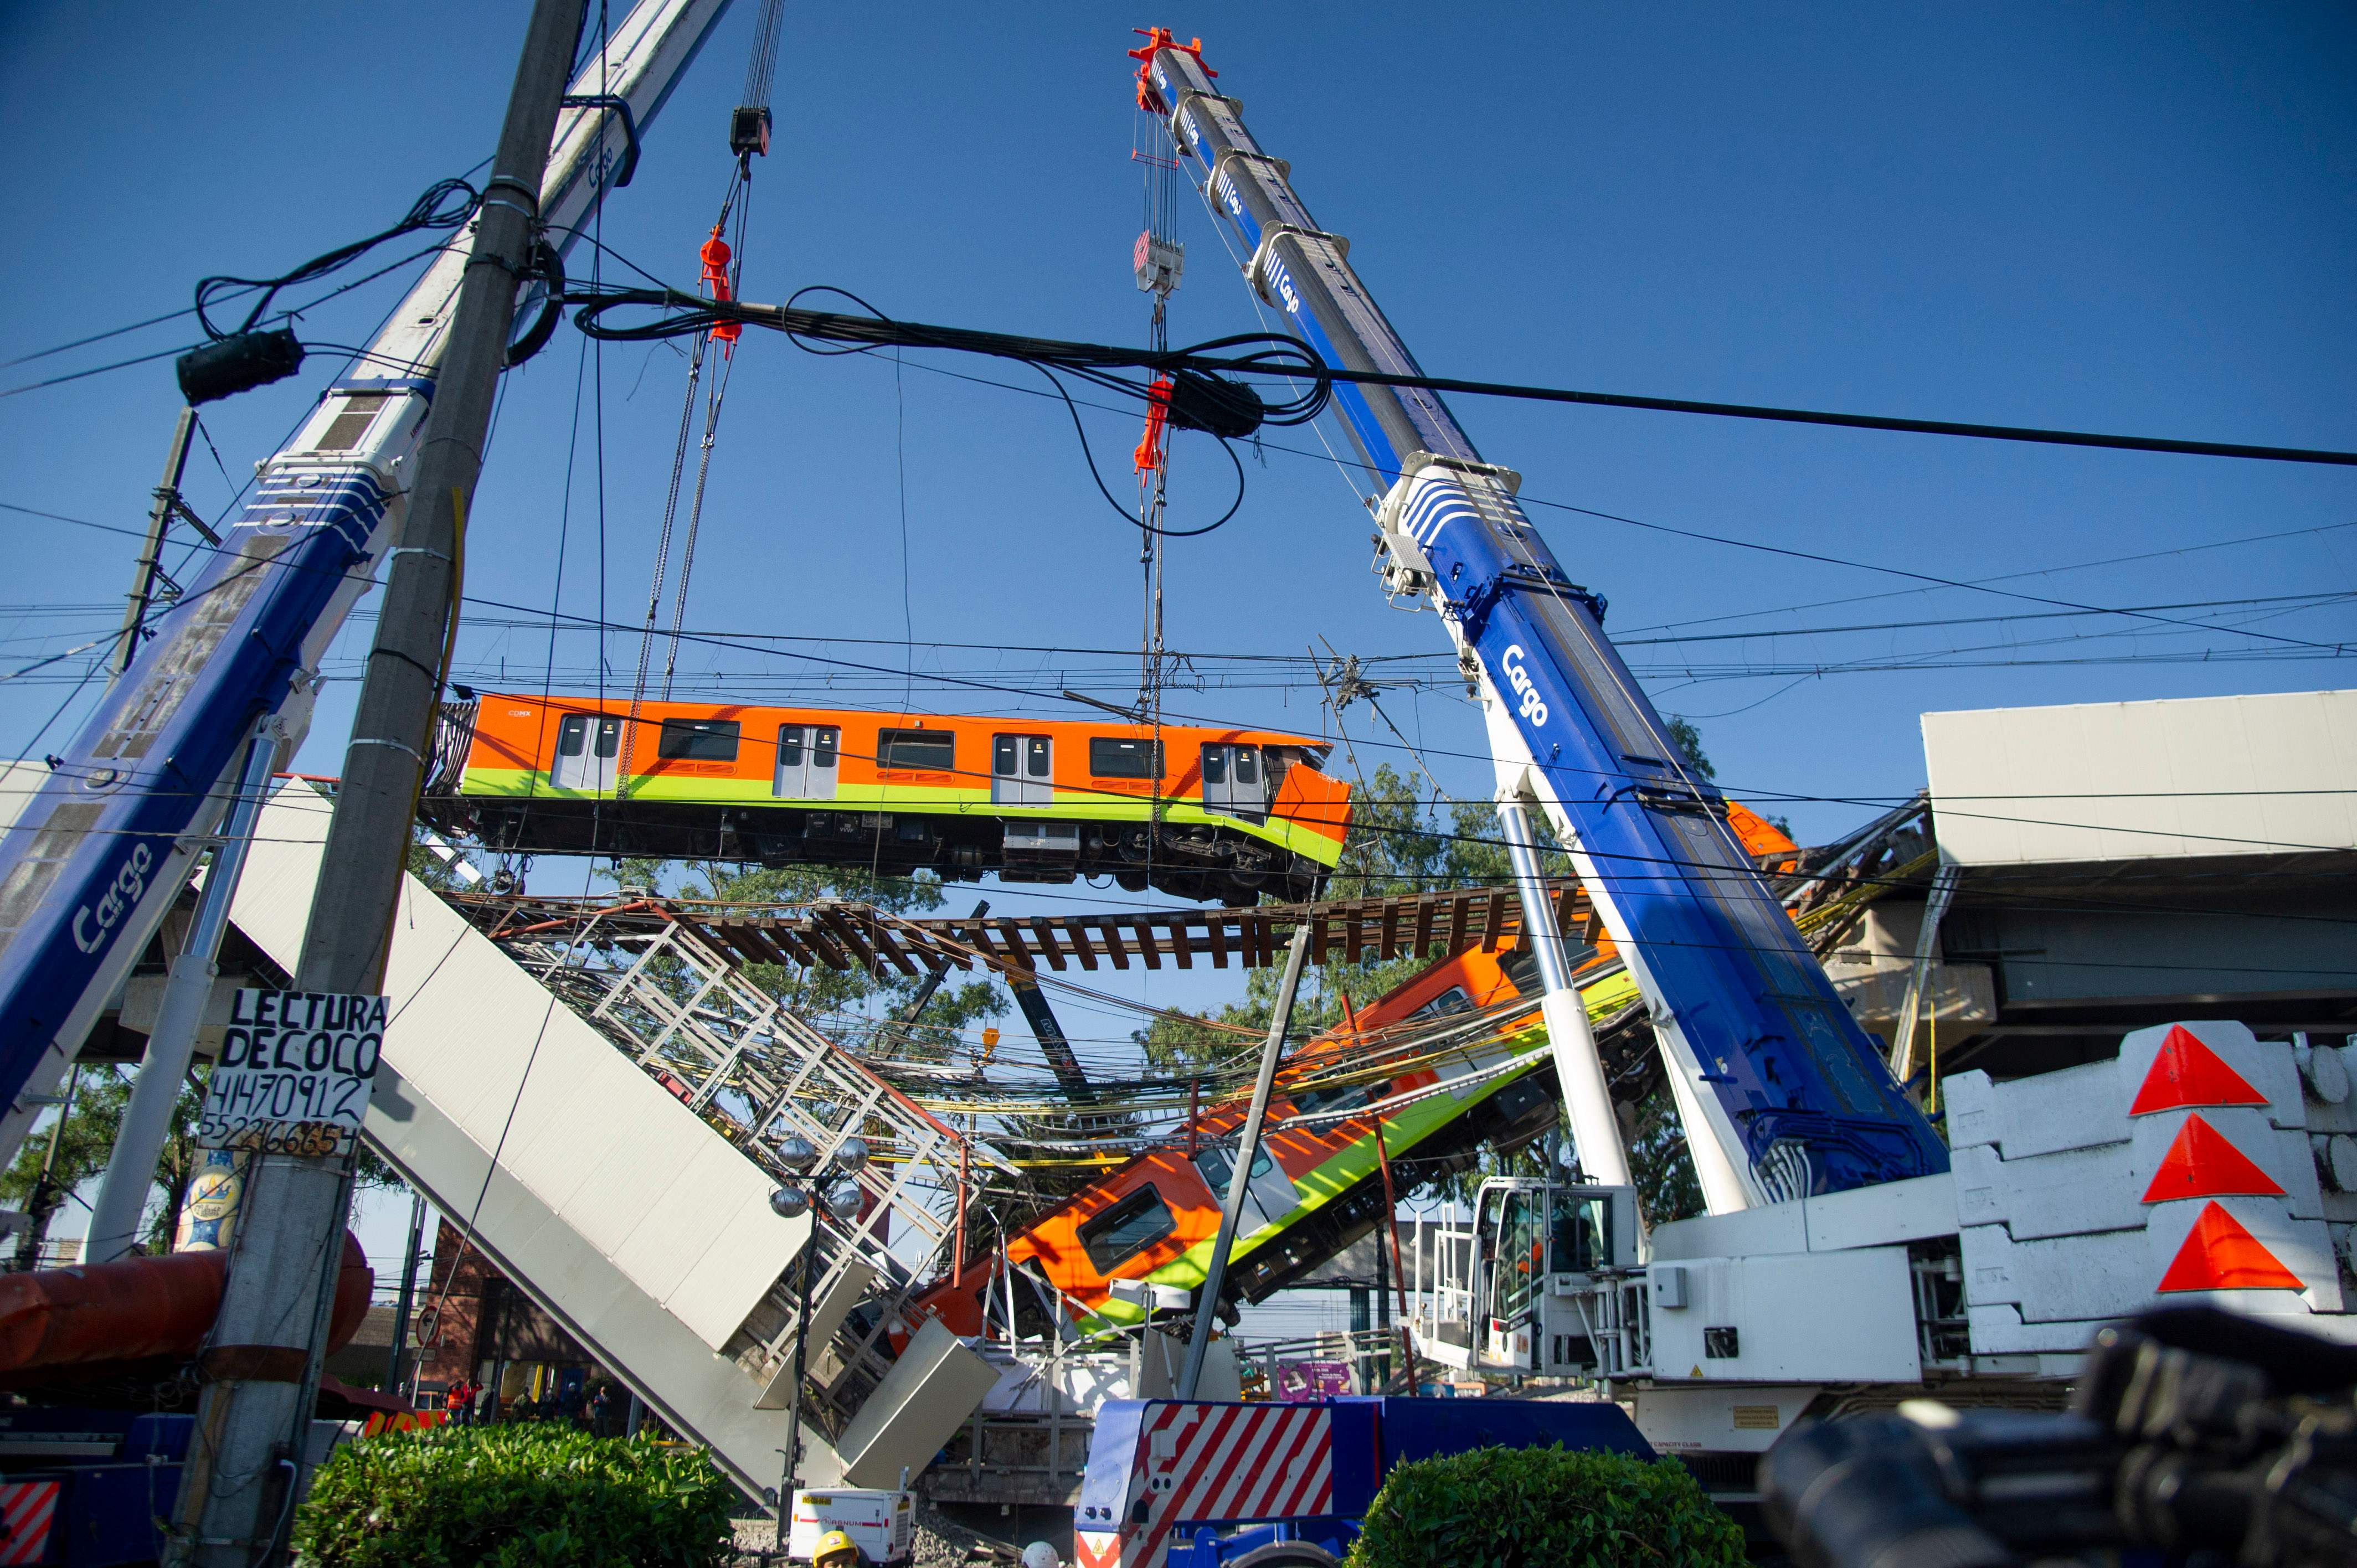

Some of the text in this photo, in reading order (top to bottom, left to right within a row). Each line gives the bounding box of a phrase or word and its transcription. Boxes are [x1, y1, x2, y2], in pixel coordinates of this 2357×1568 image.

[1280, 275, 1299, 313] Cargo
[1502, 644, 1548, 726] Cargo
[73, 843, 152, 953] Cargo
[230, 988, 386, 1033] LECTURA
[213, 1073, 361, 1125] 41470912
